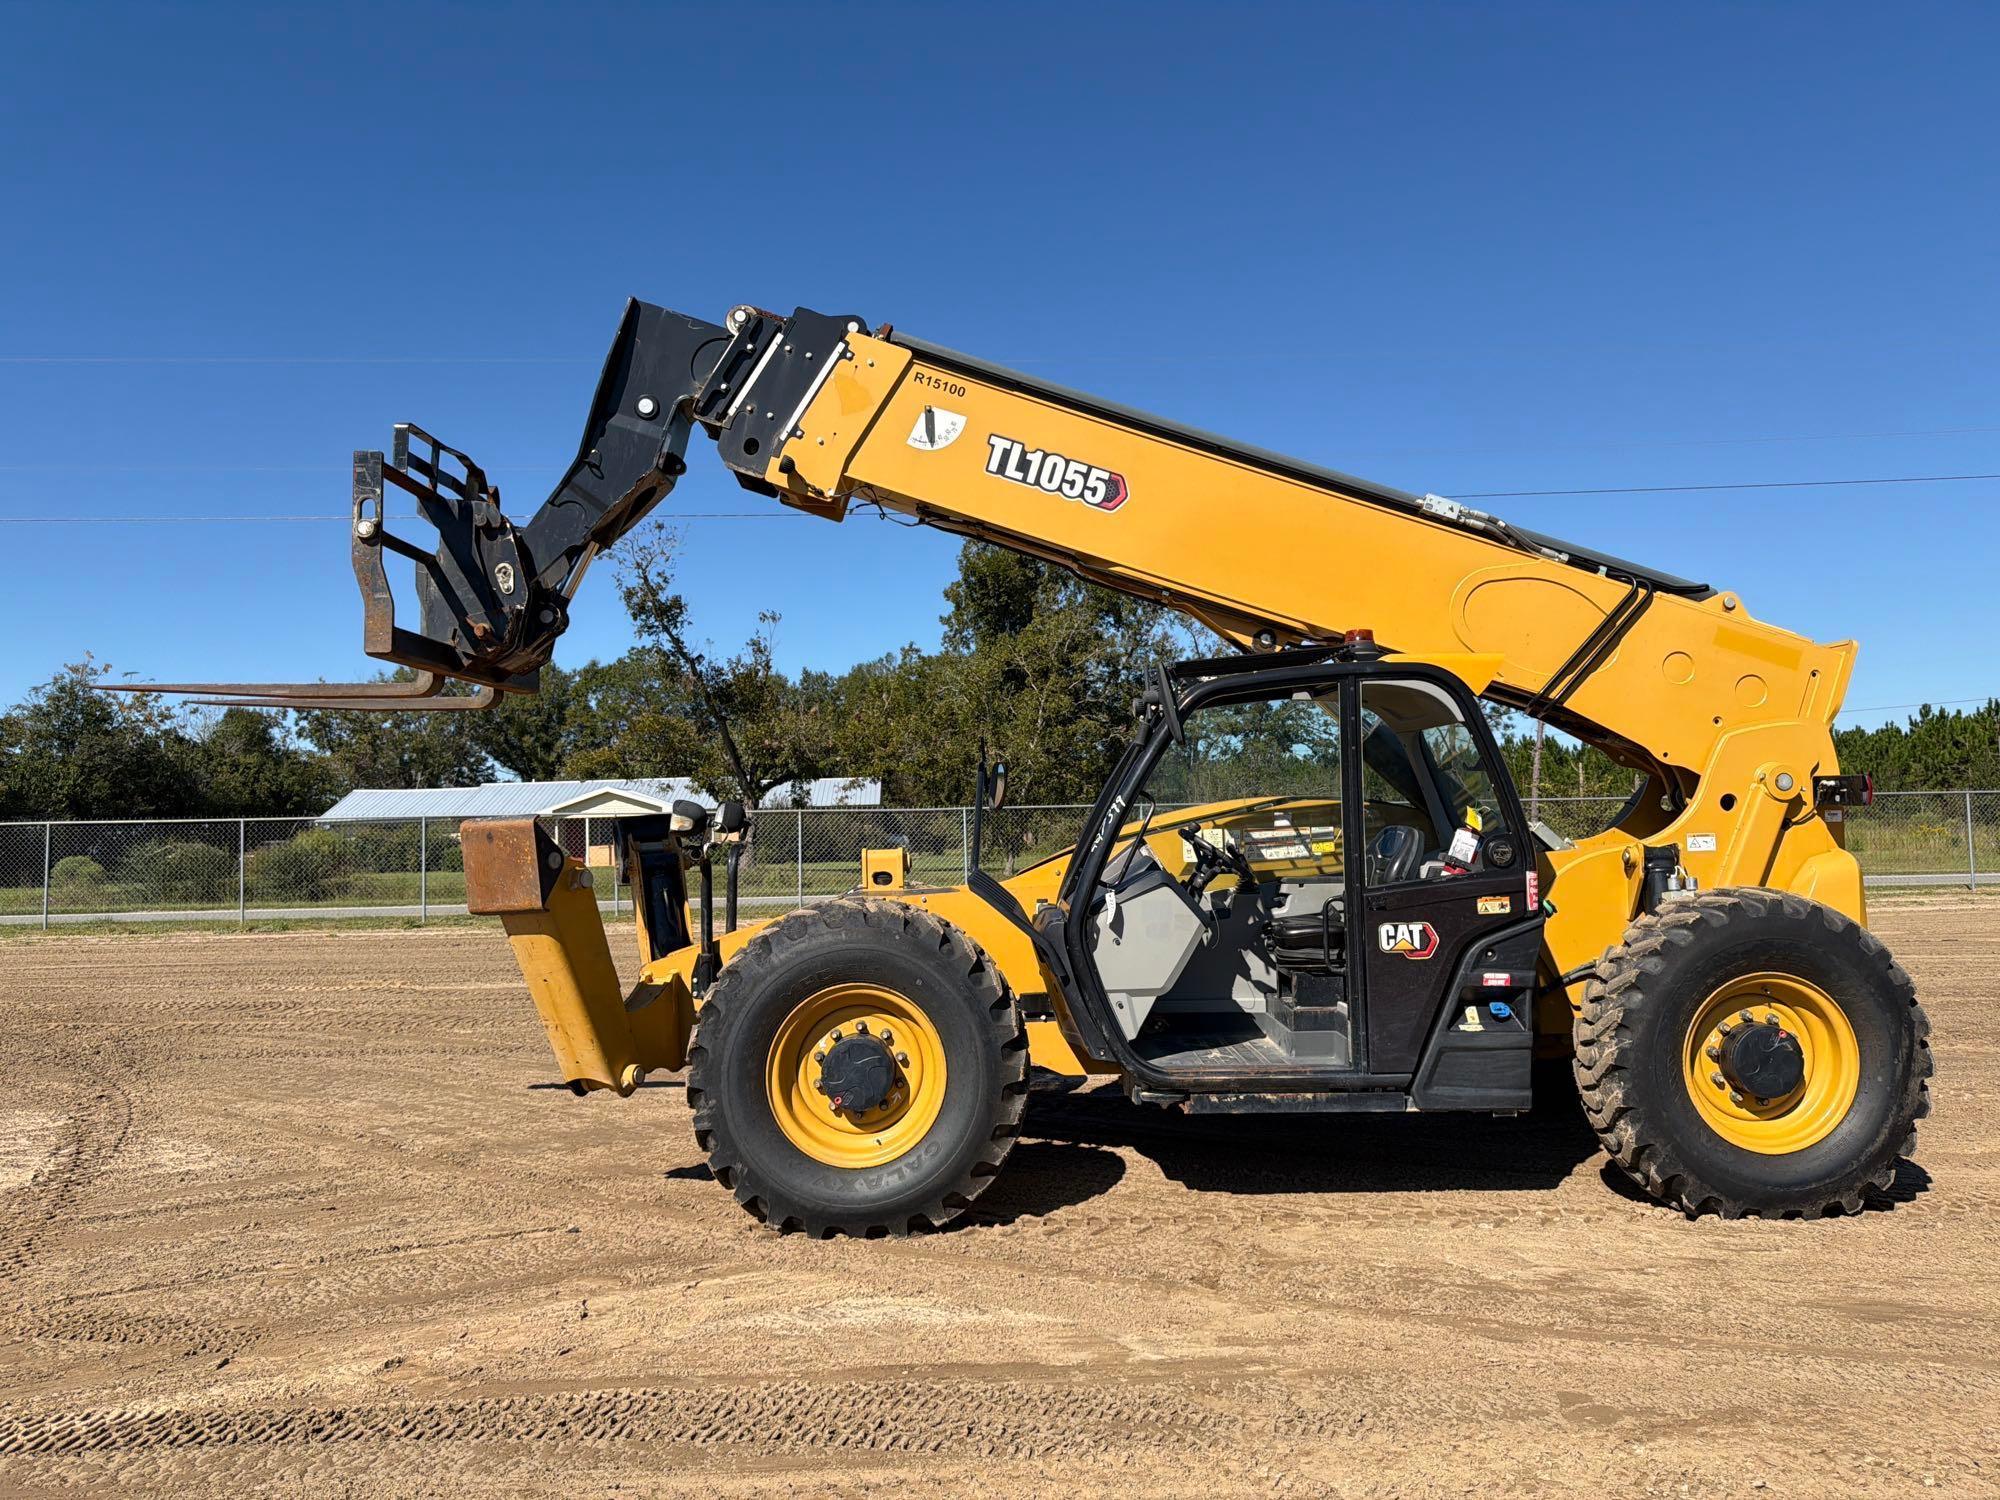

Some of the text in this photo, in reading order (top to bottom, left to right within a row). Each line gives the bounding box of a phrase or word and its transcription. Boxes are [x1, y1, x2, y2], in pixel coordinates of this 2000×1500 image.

[913, 371, 967, 399] R15100
[986, 434, 1111, 505] TL1055
[1380, 924, 1424, 951] CAT
